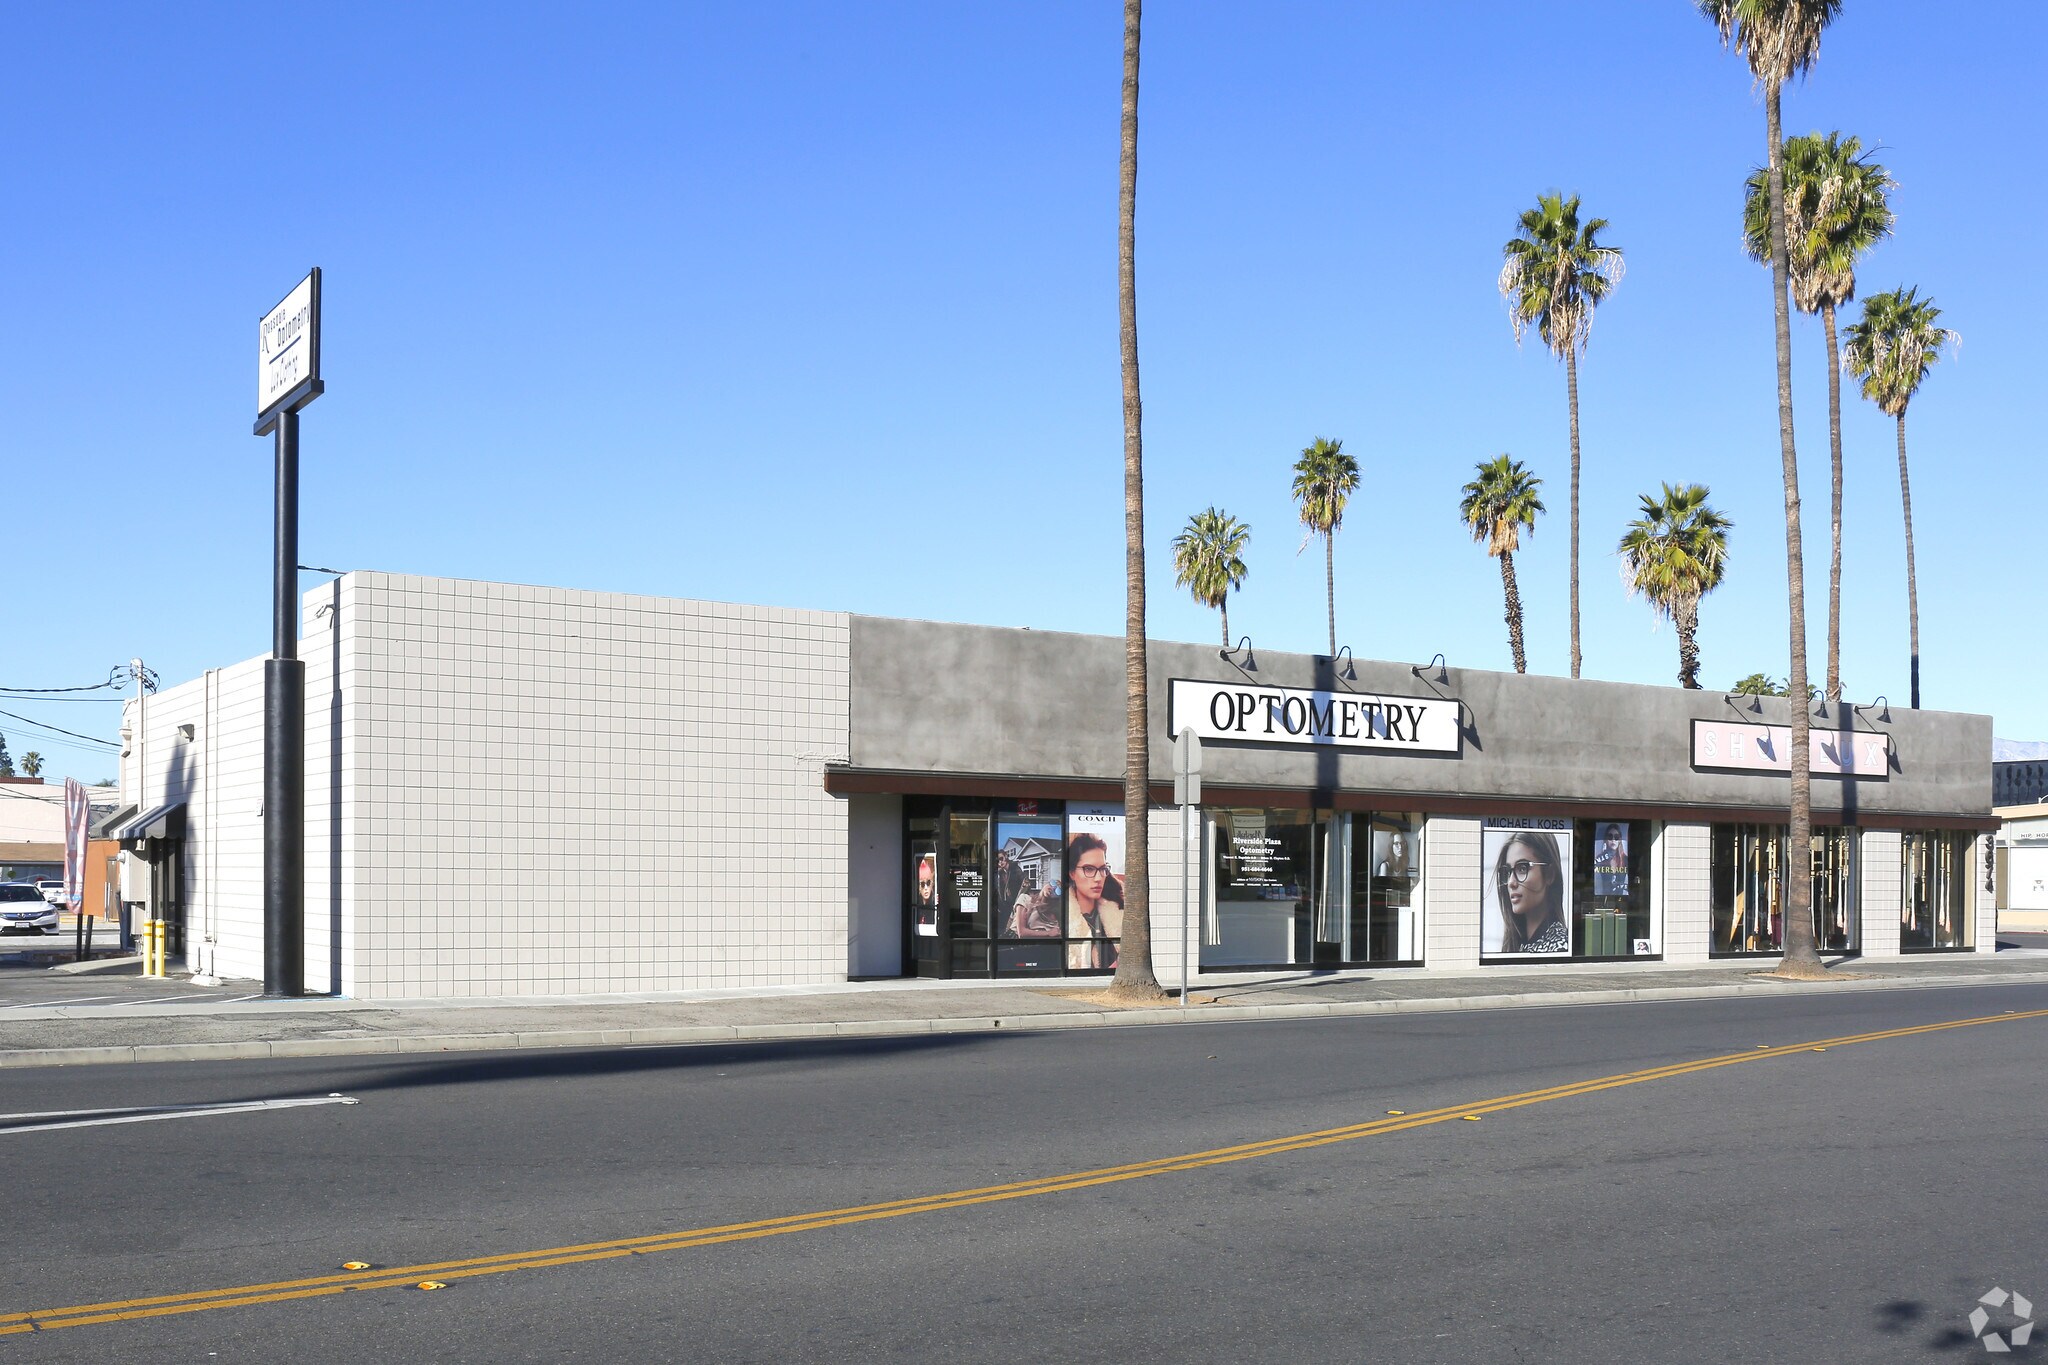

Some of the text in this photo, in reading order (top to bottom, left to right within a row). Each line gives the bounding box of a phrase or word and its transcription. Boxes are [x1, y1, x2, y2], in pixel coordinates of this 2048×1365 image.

[1210, 691, 1427, 742] OPTOMETRY
[1819, 738, 1879, 767] LUX
[1487, 817, 1565, 830] MICHAEL KORS
[1240, 847, 1274, 855] Optometry
